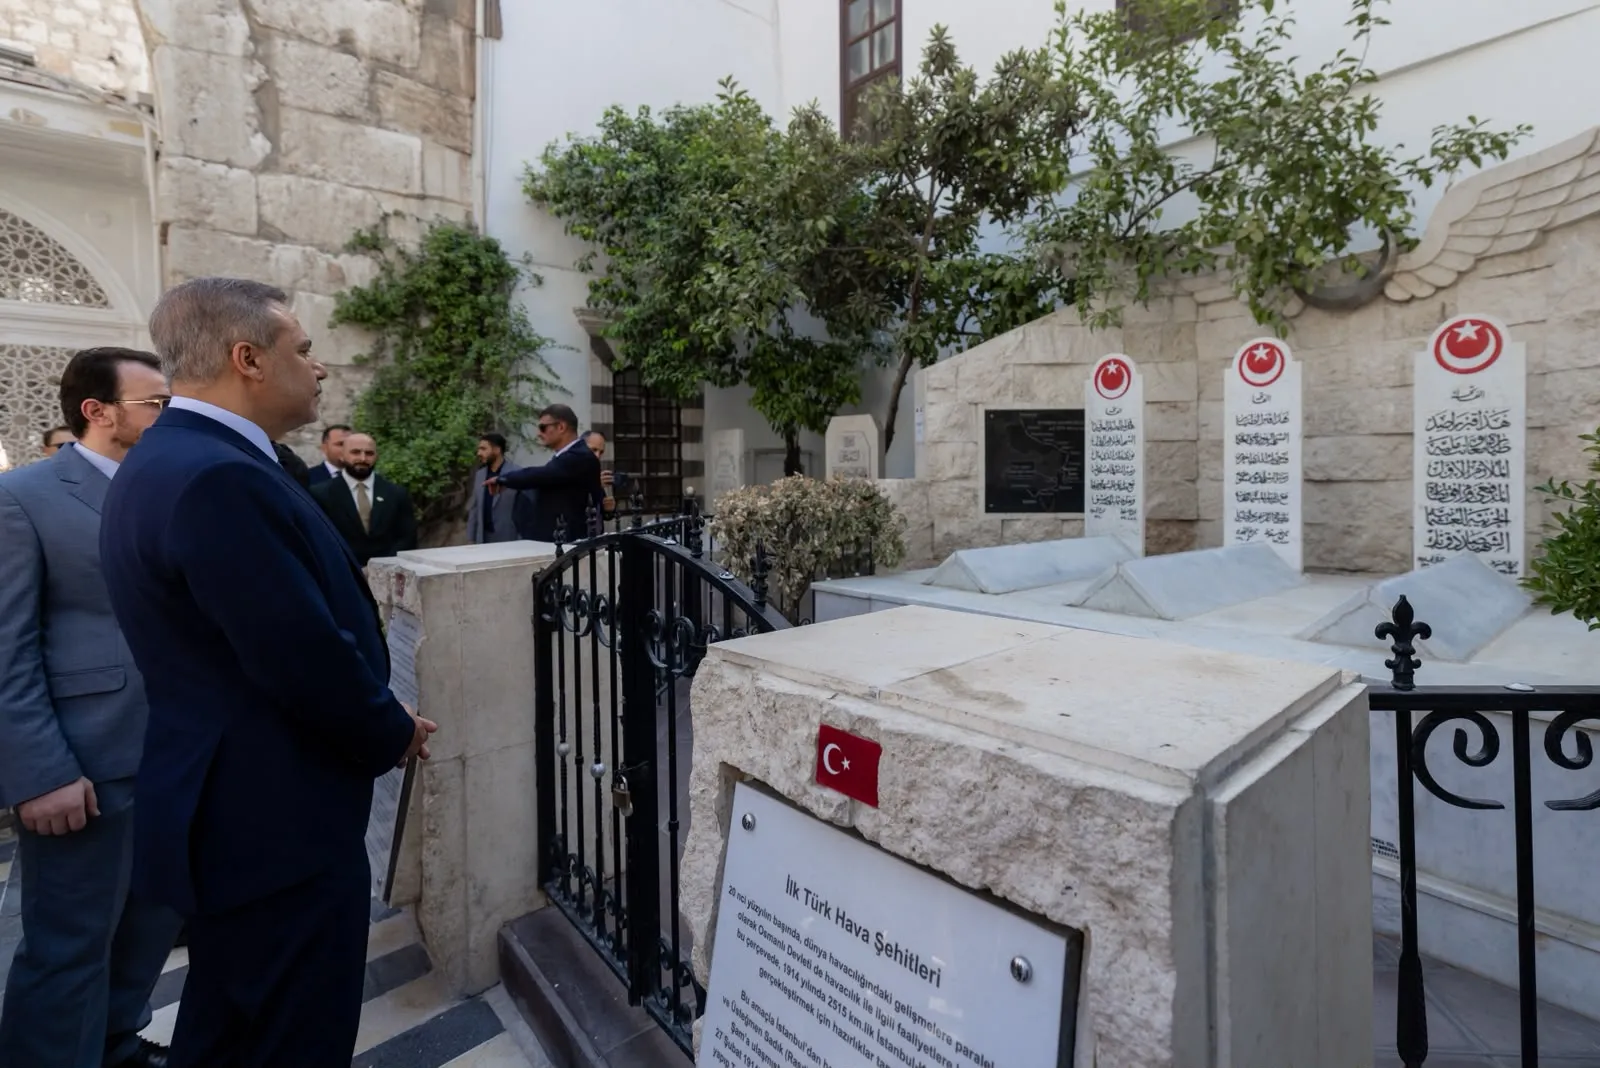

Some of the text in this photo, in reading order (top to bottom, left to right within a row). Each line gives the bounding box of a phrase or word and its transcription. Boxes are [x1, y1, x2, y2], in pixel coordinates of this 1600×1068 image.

[728, 885, 737, 897] 20
[737, 892, 747, 904] nci
[747, 900, 772, 922] yüzyılın
[773, 914, 802, 945] başında,
[803, 937, 828, 960] dünya
[829, 952, 893, 1005] havacılığındaki
[736, 927, 746, 941] bu
[746, 936, 781, 969] çerçevede,
[783, 962, 800, 982] 1914
[800, 975, 826, 1002] yılında
[827, 995, 848, 1018] 2515
[785, 874, 942, 988] İlk Türk Hava Şehitleri
[722, 995, 730, 1008] ve
[730, 999, 763, 1037] Üsteğmen
[763, 1030, 784, 1056] Sadık
[738, 911, 757, 932] olarak
[758, 924, 786, 952] Osmanlı
[787, 945, 812, 970] Devleti
[813, 964, 824, 979] de
[825, 971, 861, 1006] havacılık
[862, 998, 874, 1014] ile
[875, 1006, 895, 1031] ilgili
[897, 1022, 953, 1068] faaliyetlere
[740, 989, 750, 1005] Bu
[751, 1000, 775, 1027] amaçla
[758, 967, 875, 1062] gerçekleştirmek için hazırlıklar
[715, 1027, 723, 1040] 27
[723, 1034, 742, 1060] Şubat
